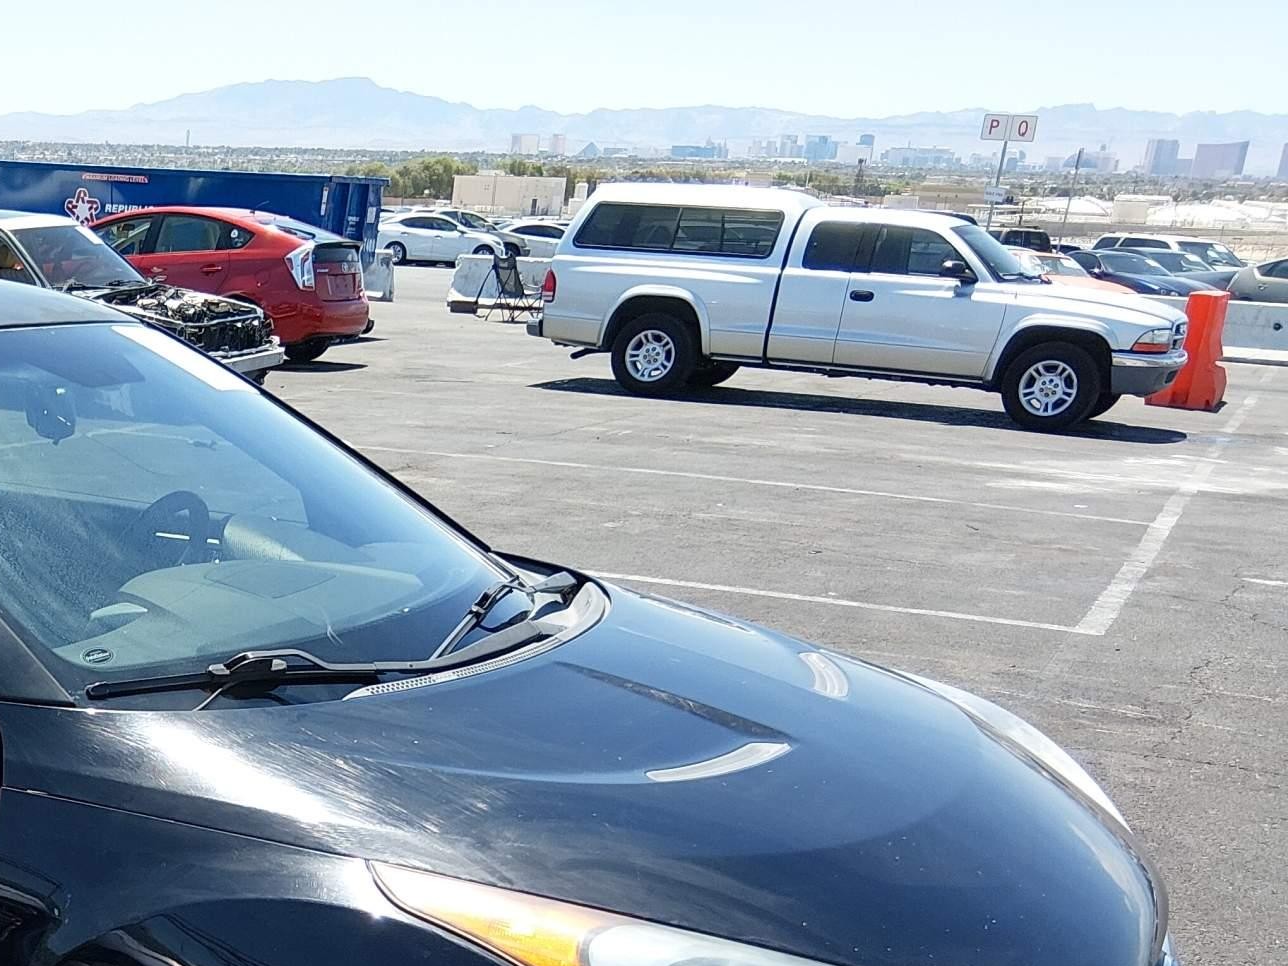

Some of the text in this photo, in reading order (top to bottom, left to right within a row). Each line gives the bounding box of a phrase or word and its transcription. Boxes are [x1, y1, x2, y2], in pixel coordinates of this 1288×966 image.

[989, 119, 1029, 137] P Q
[104, 203, 155, 213] REPUB
